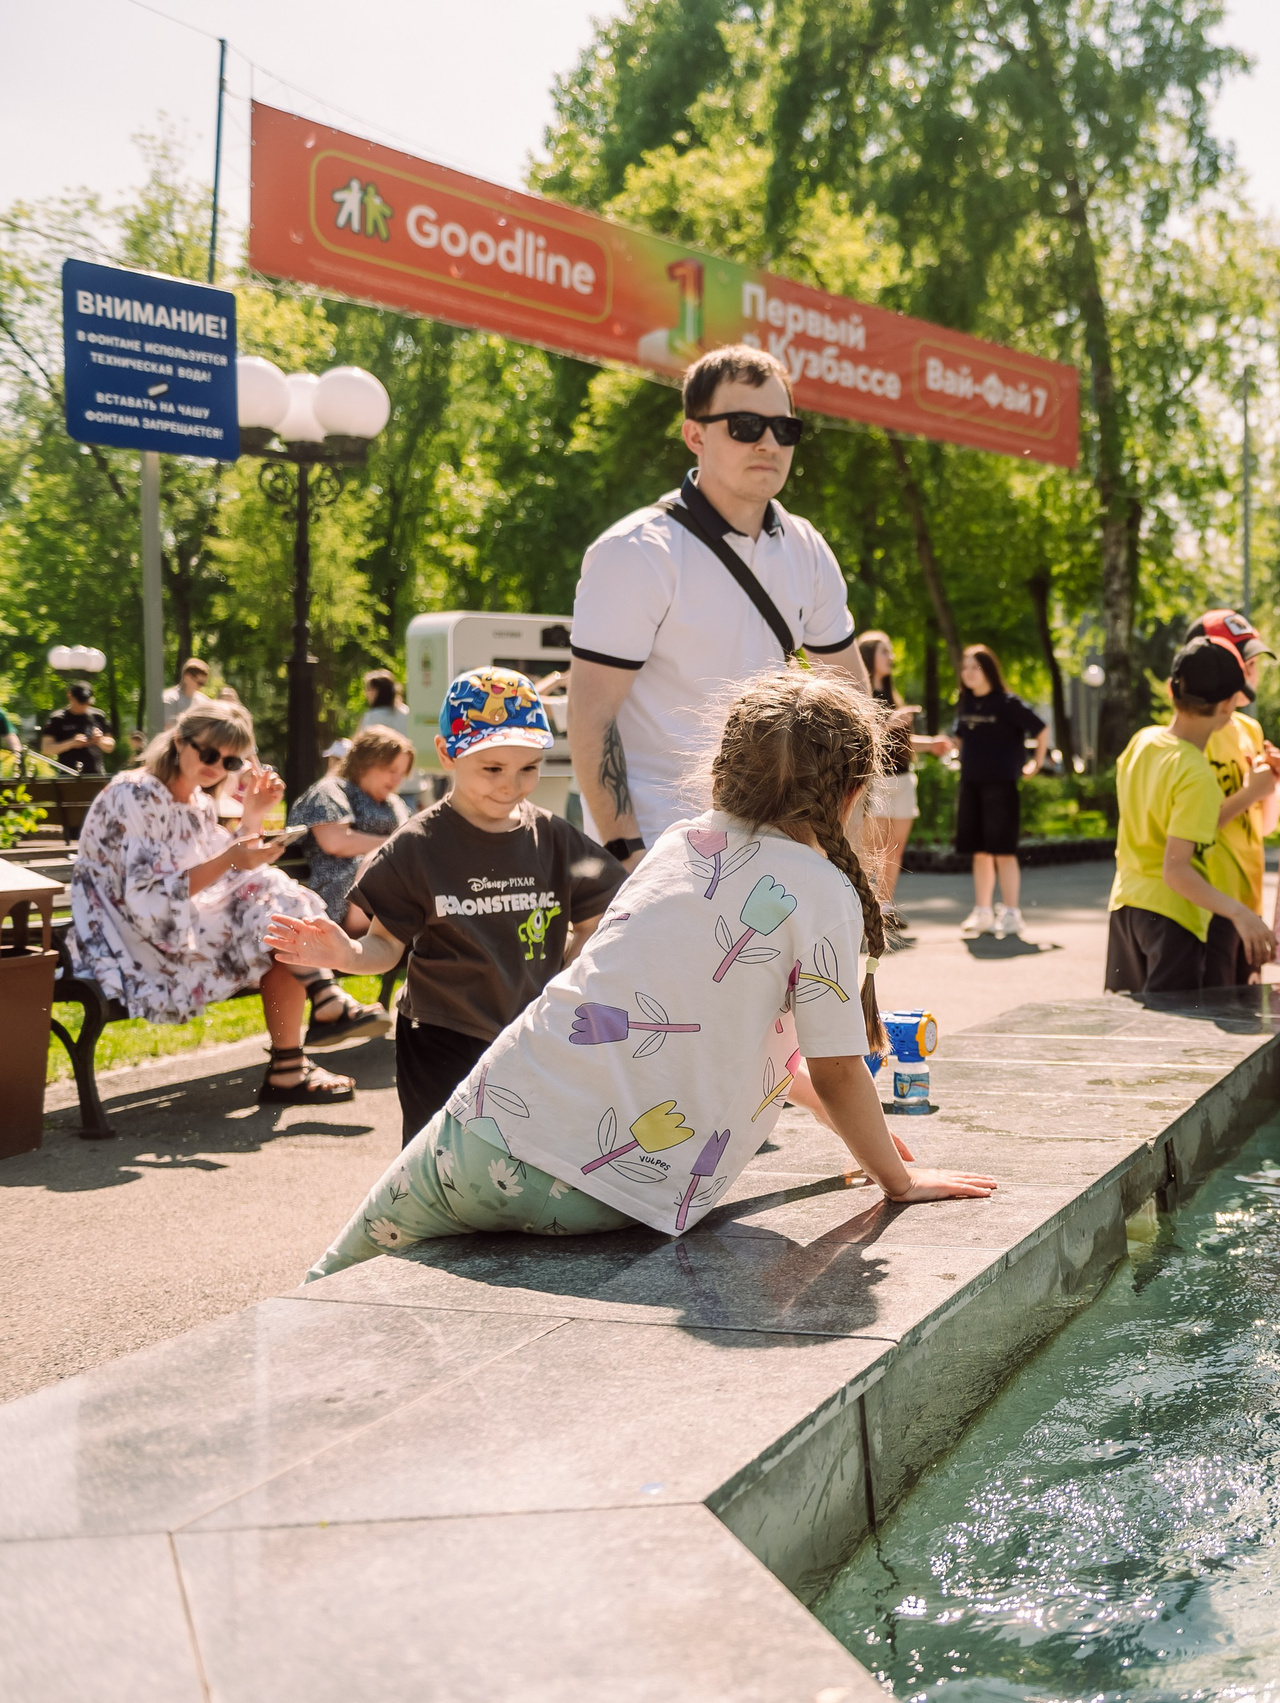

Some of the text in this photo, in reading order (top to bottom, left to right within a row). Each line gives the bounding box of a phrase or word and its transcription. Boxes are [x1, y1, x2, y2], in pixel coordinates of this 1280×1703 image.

[406, 204, 597, 296] Goodline
[76, 290, 228, 340] ВНИМАНИЕ!
[741, 281, 868, 352] Первый
[76, 330, 229, 367] В ФОНТАНЕ ИСПОЛЬЗУЕТСЯ
[90, 351, 213, 383] ТЕХНИЧЕСКАЯ ВОДА!
[767, 331, 903, 401] Кузбассе
[95, 390, 211, 420] ВСТАВАТЬ НА ЧАШУ
[925, 355, 1049, 418] Вай-Фай 7
[84, 409, 225, 441] ФОНТАНА ЗАПРЕЩАЕТСЯ!
